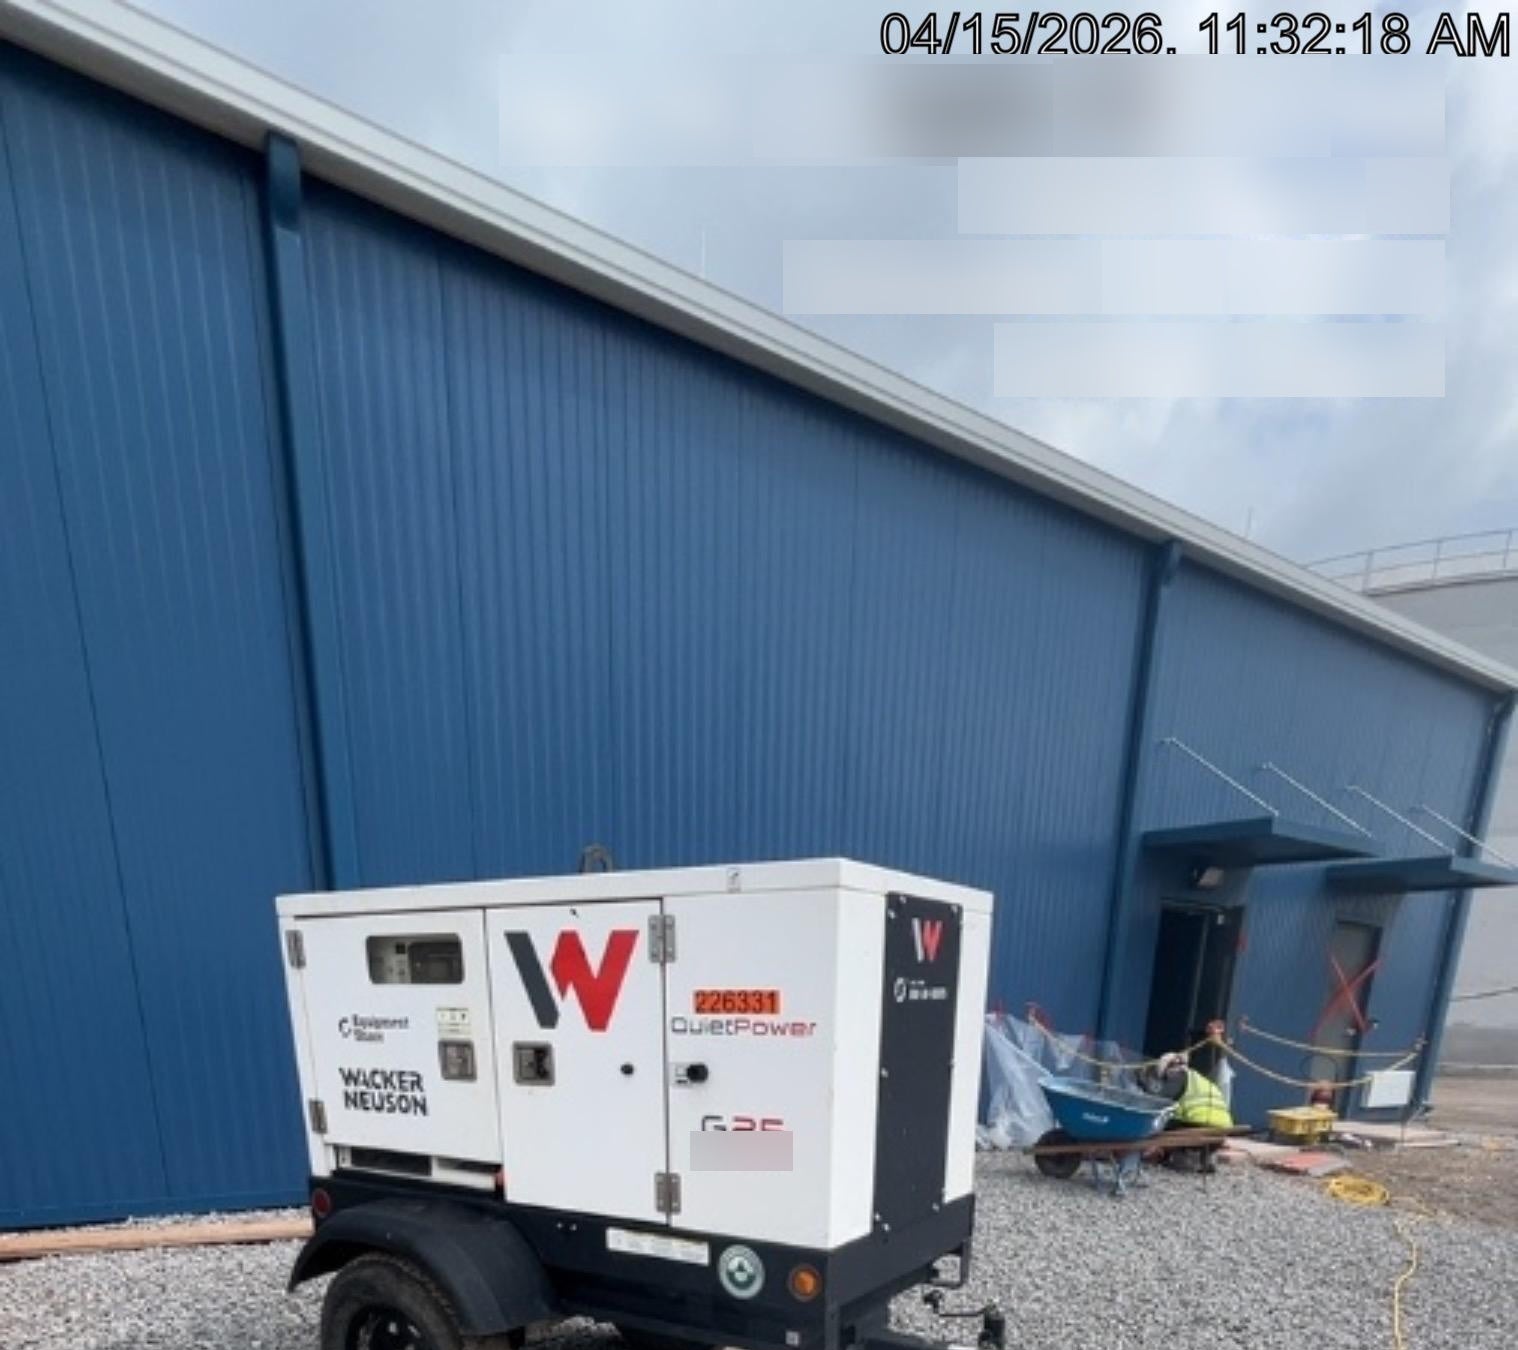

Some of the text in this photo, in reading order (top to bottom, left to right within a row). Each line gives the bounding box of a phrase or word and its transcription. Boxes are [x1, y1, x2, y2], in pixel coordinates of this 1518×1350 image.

[695, 990, 775, 1014] 226331
[671, 1016, 816, 1036] QuietPower
[338, 1067, 424, 1092] WACKER
[344, 1091, 428, 1116] NEUSON
